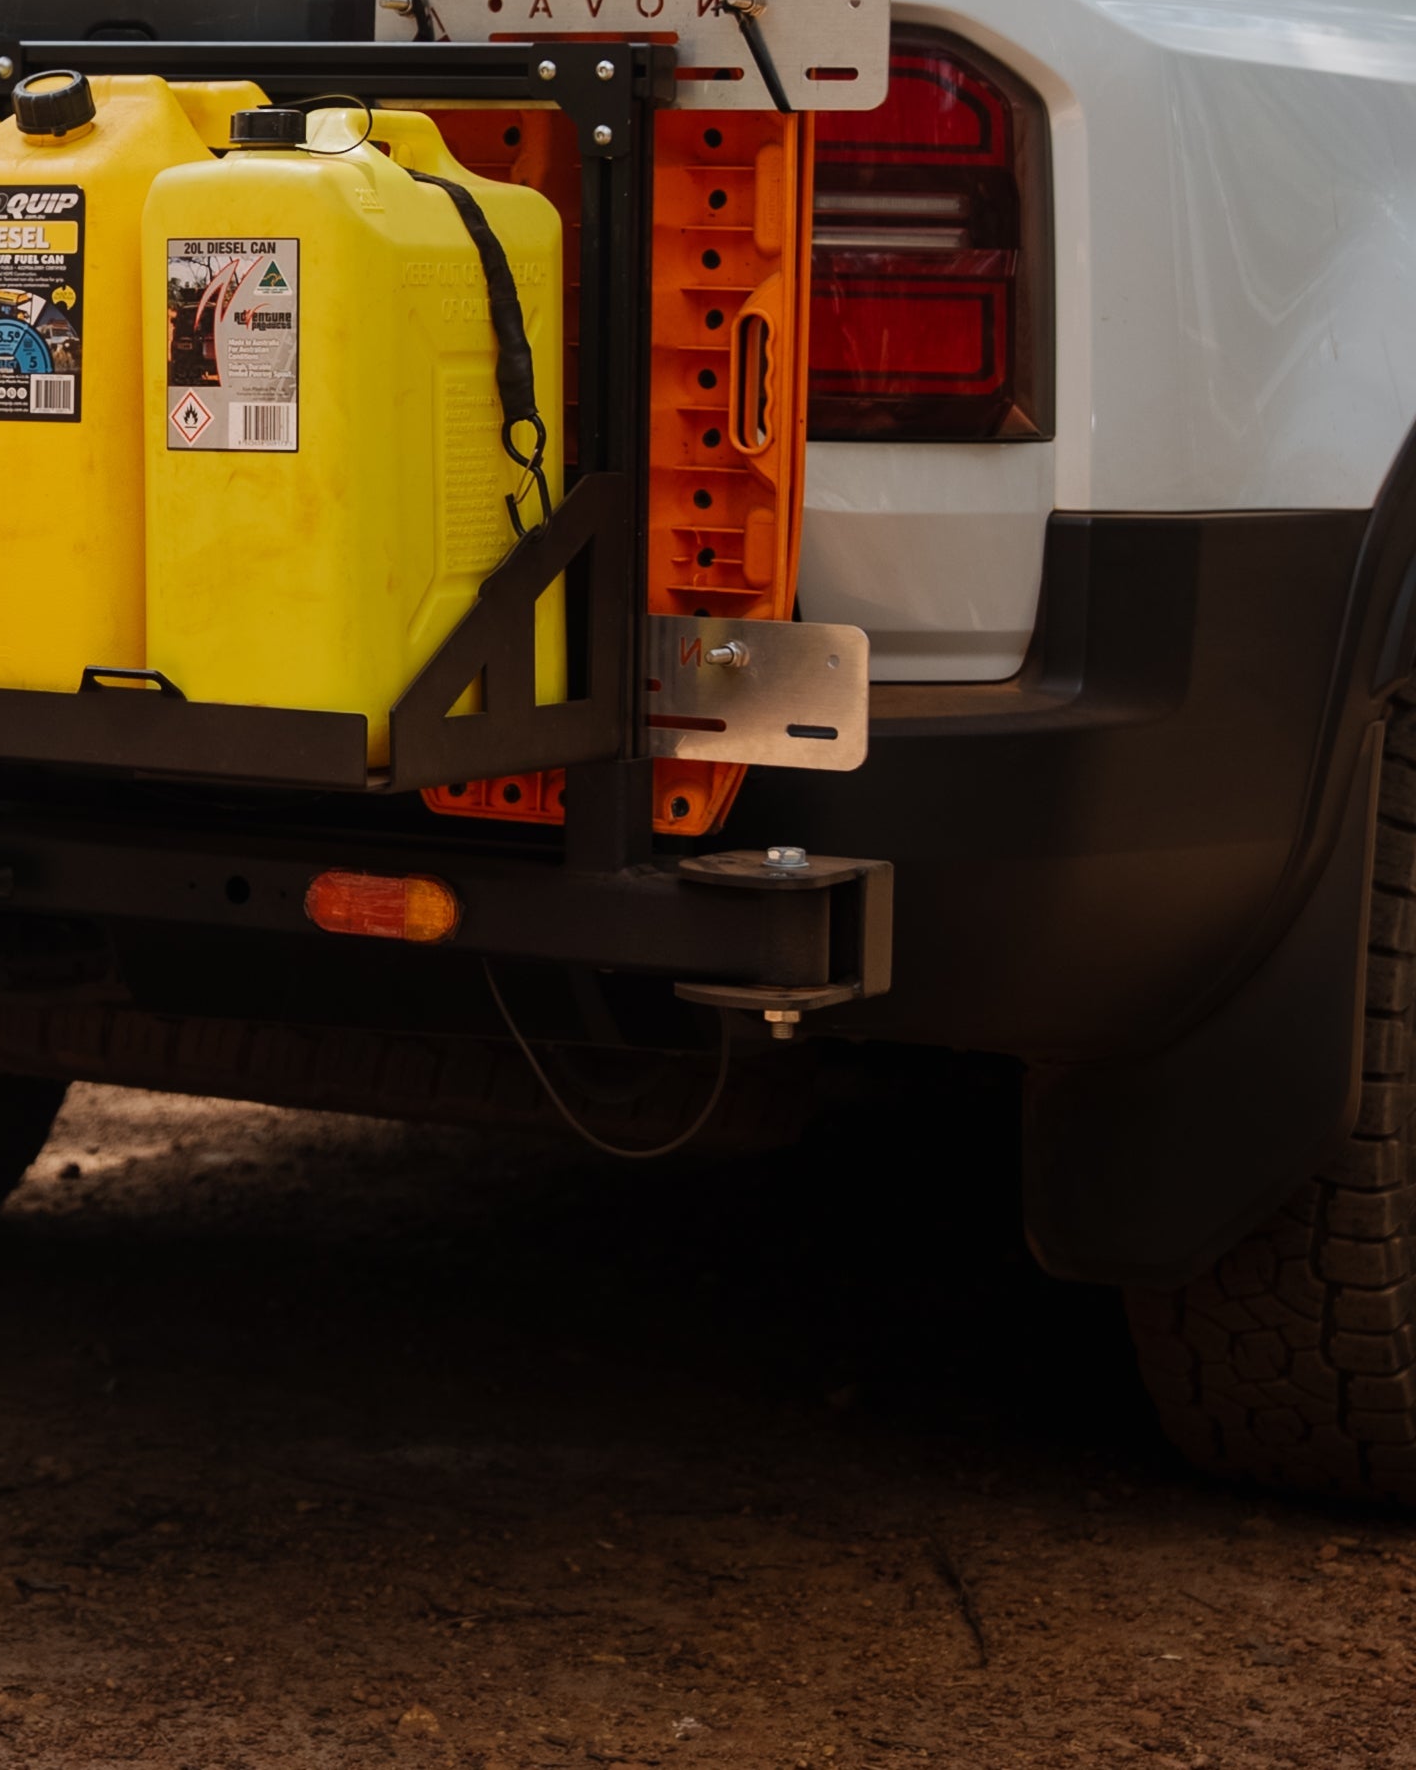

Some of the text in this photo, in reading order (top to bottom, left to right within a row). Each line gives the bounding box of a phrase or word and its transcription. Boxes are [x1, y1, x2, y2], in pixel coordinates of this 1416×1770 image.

[184, 242, 276, 254] 20L DIESEL CAN
[14, 255, 39, 265] FUEL
[41, 255, 65, 265] CAN
[436, 262, 461, 287] OUT
[29, 356, 37, 368] 5
